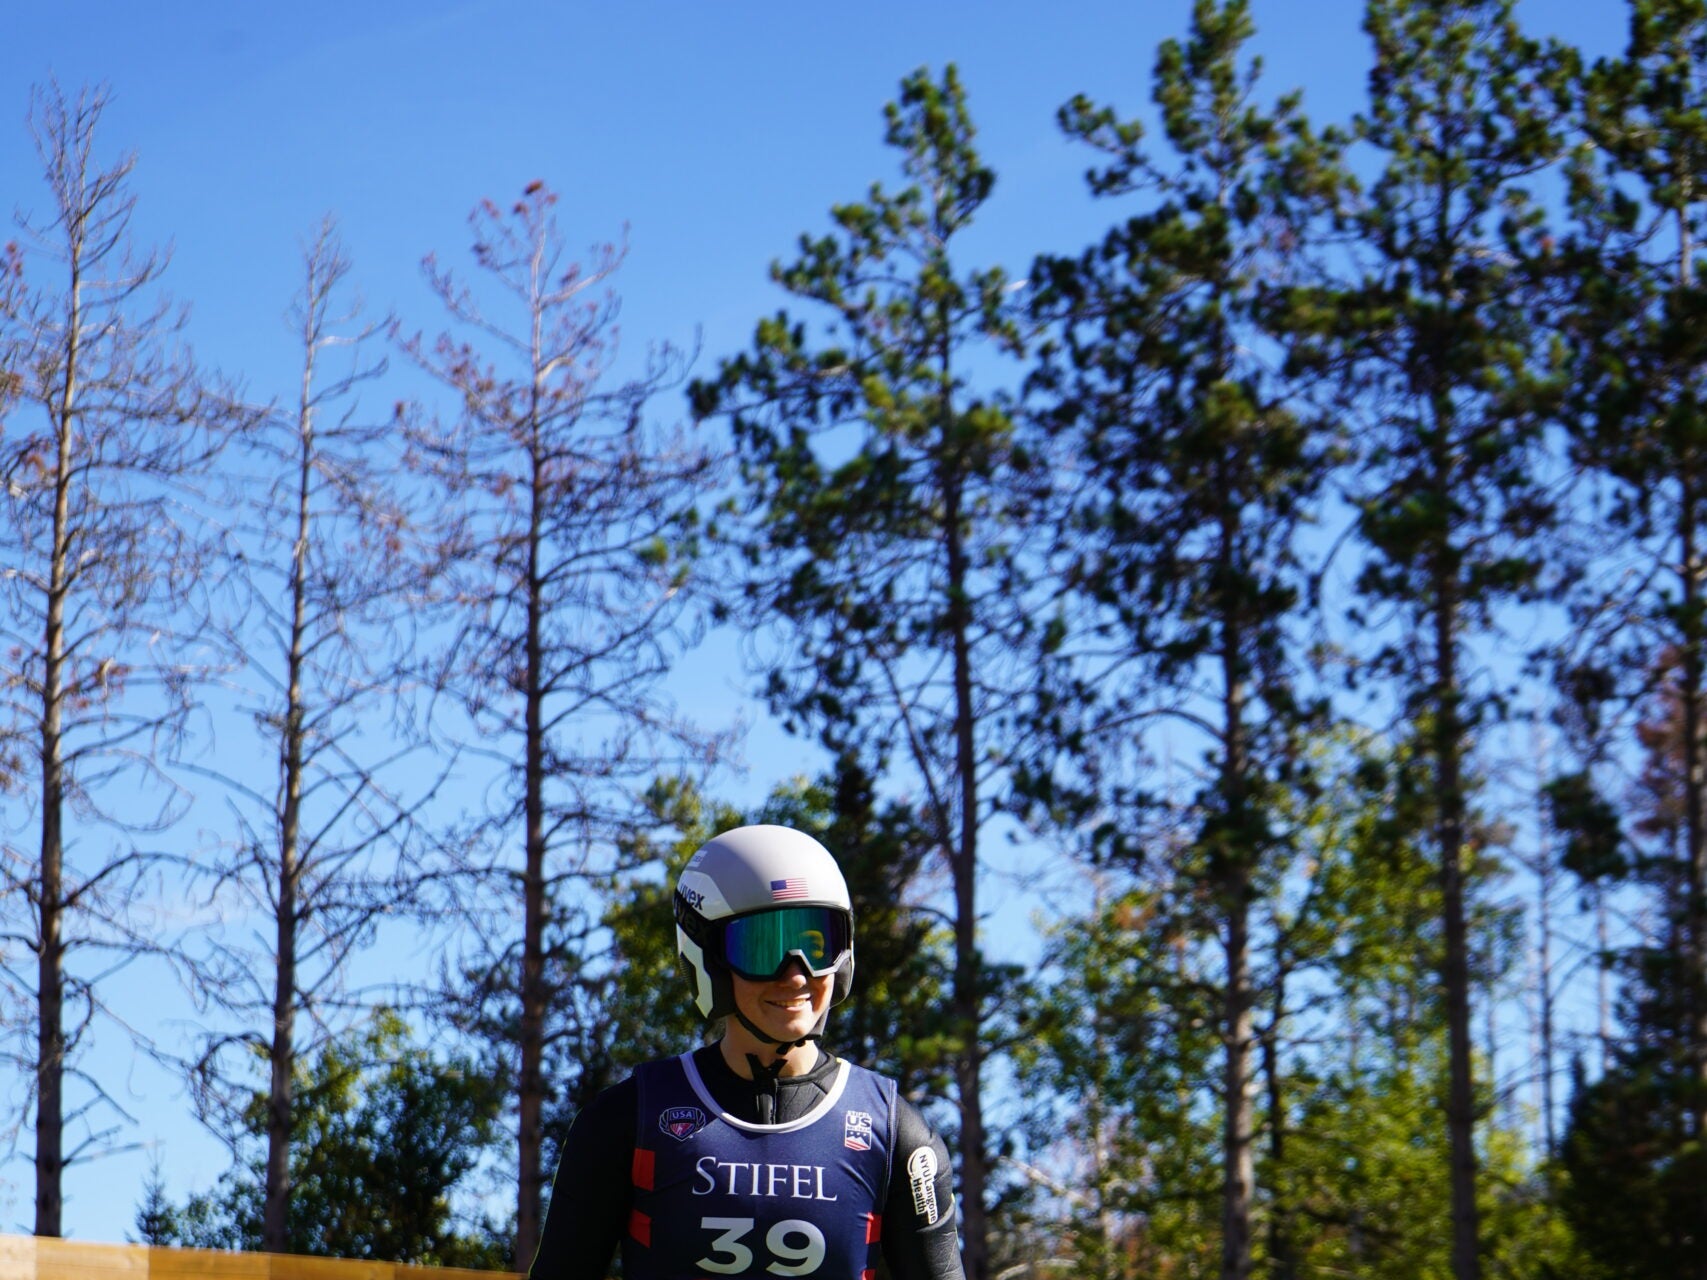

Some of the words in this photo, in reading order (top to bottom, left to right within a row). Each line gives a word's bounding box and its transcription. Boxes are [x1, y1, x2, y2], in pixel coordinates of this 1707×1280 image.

[672, 1111, 693, 1119] USA
[847, 1115, 871, 1128] US
[692, 1156, 838, 1202] STIFEL
[919, 1154, 932, 1178] NYU
[913, 1178, 927, 1213] Health
[924, 1179, 937, 1223] Langone
[695, 1216, 826, 1277] 39
